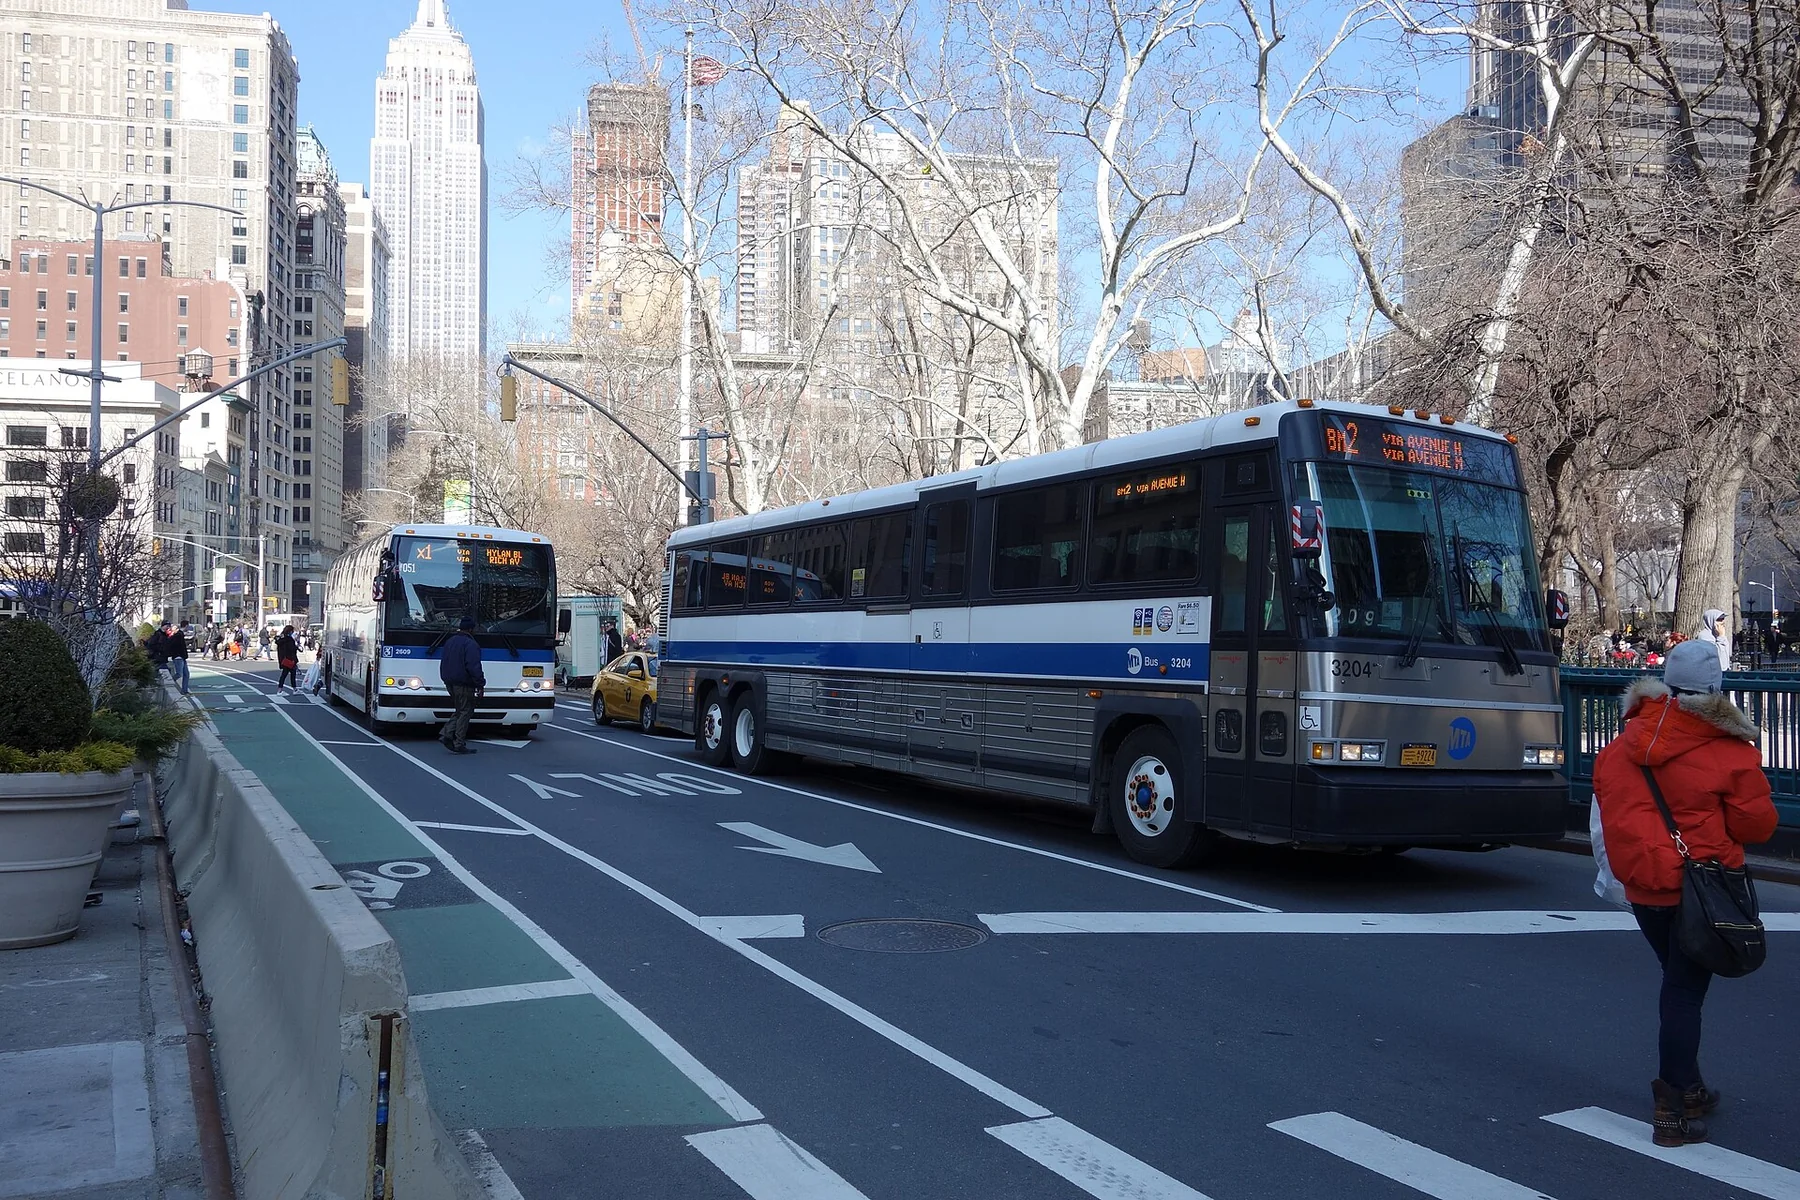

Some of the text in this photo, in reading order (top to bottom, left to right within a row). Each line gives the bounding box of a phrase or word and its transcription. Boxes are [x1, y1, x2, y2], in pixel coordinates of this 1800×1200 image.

[1326, 422, 1359, 454] BM2
[1382, 432, 1404, 447] VIA
[1407, 434, 1451, 454] AVENUE
[1383, 448, 1405, 462] VIA
[1408, 449, 1451, 468] AVENUE
[1116, 482, 1131, 496] BM2
[1136, 484, 1149, 493] VIA
[1151, 475, 1178, 491] AVENUE
[486, 548, 511, 559] HYLAN
[513, 550, 523, 559] BL
[489, 556, 508, 565] RICH
[509, 558, 520, 566] AV
[1144, 656, 1159, 667] Bus
[1170, 657, 1192, 669] 3204
[1331, 659, 1372, 678] 3204
[1448, 723, 1473, 754] MTA
[508, 772, 743, 800] ONLY
